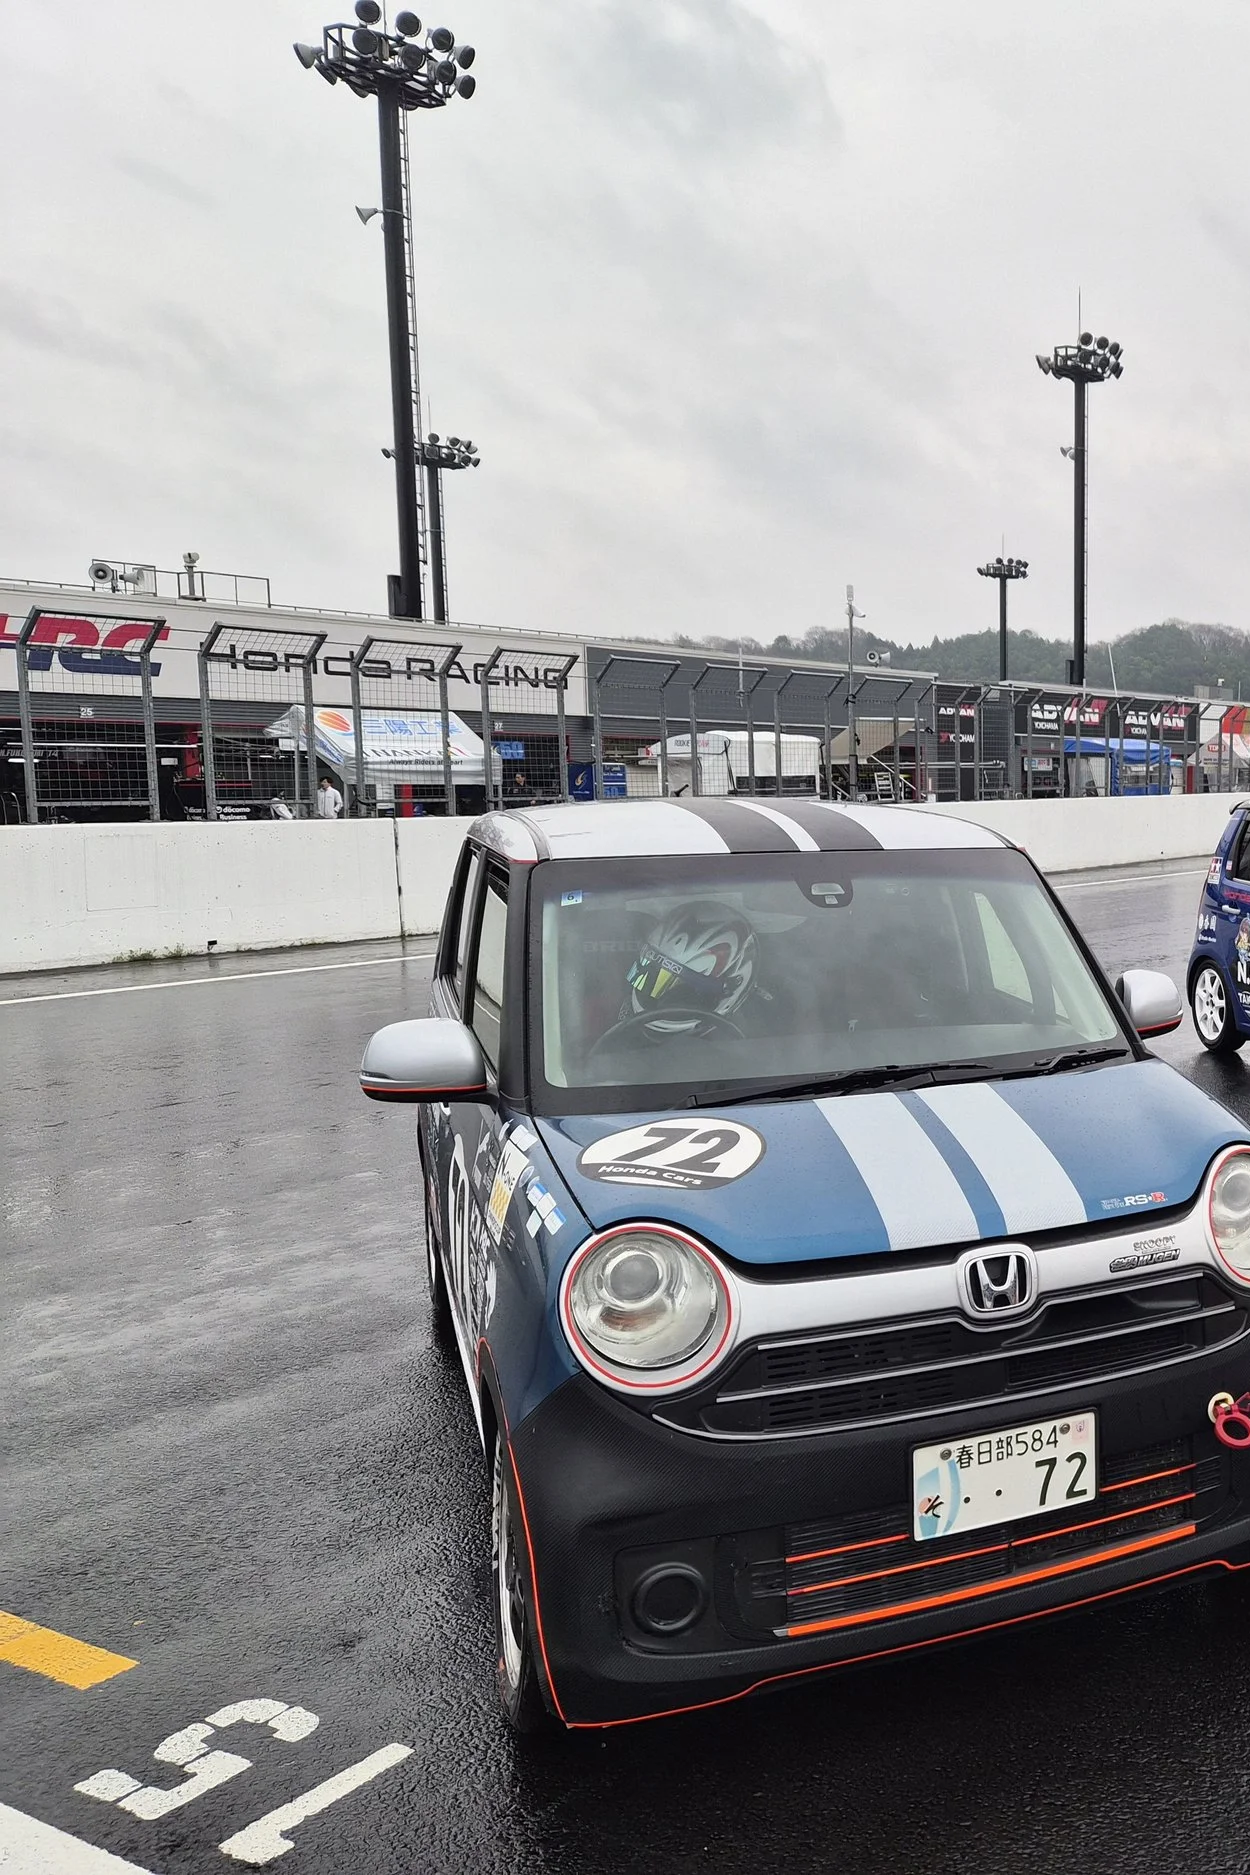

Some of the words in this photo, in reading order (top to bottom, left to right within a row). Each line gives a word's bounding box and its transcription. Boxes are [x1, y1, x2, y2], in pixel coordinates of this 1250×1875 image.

[406, 656, 568, 690] RACING
[80, 707, 93, 716] 25
[938, 706, 975, 717] ADAN
[223, 806, 251, 814] docomo
[612, 1127, 741, 1174] 72
[597, 1163, 659, 1177] Honda
[663, 1171, 703, 1186] Cars
[1138, 1249, 1180, 1268] MUGEN
[1034, 1451, 1089, 1508] 72
